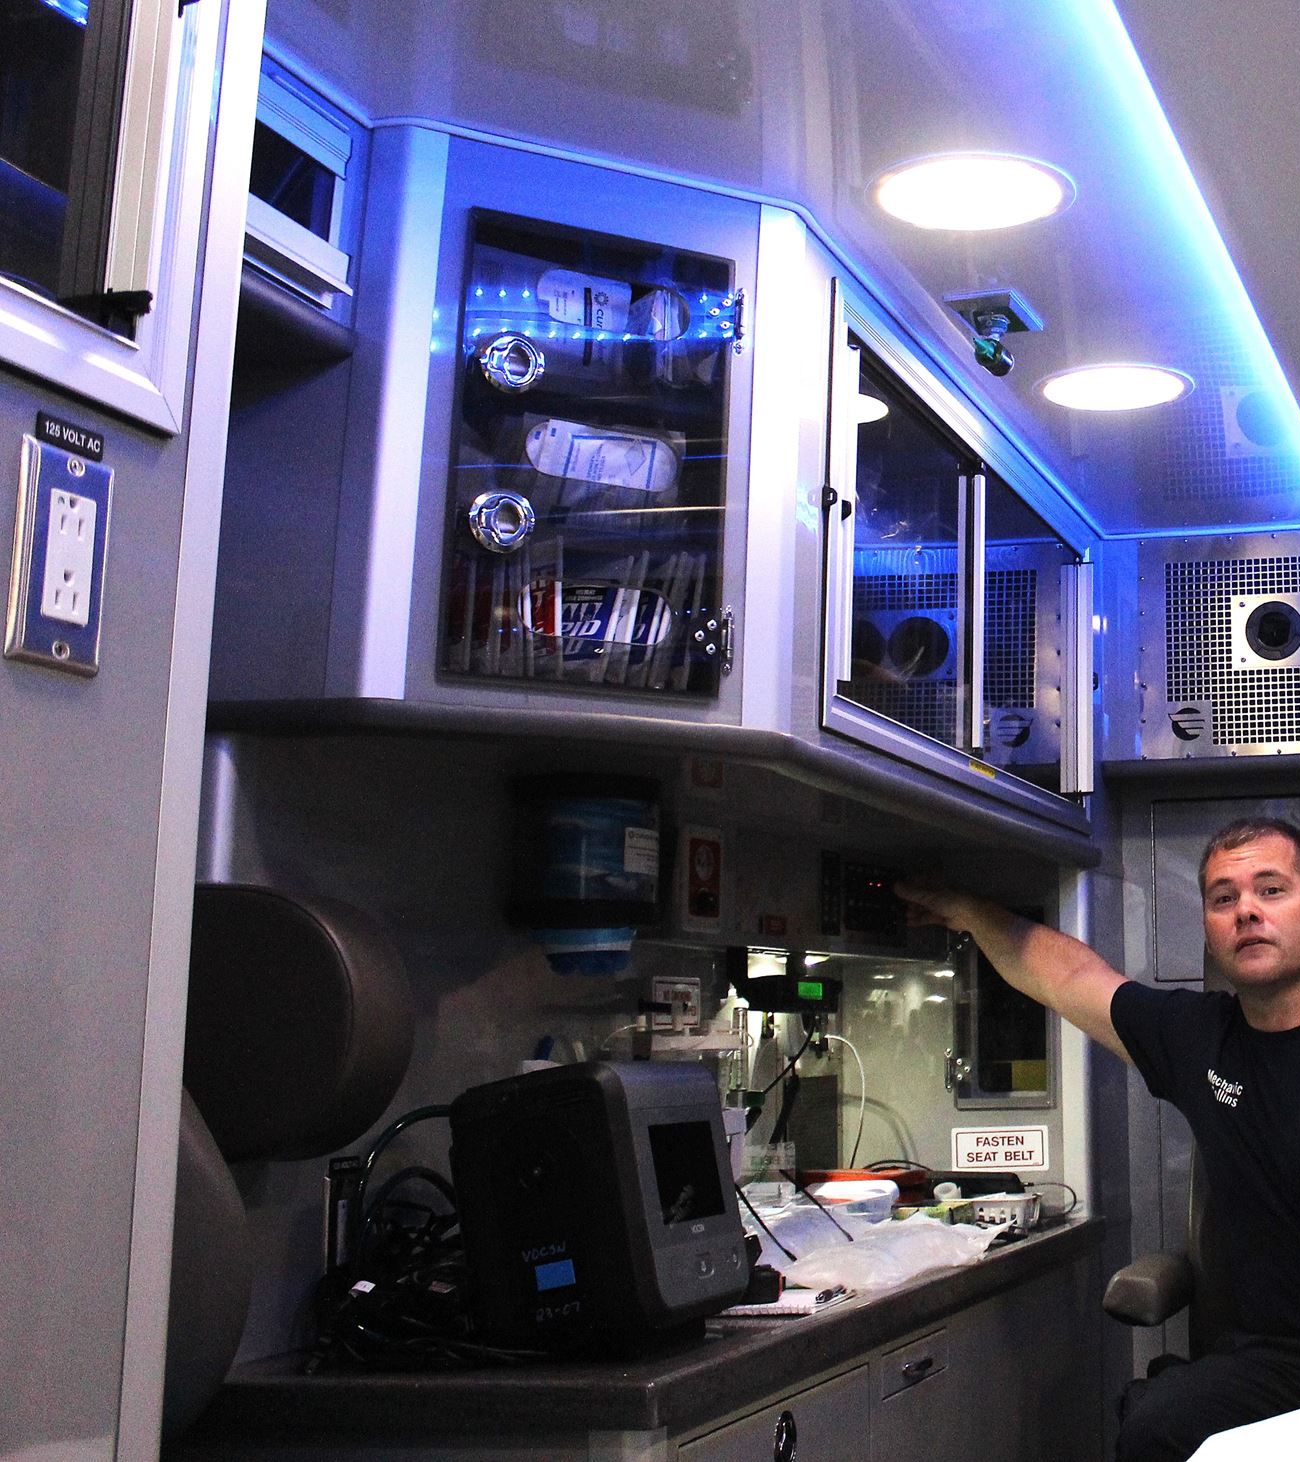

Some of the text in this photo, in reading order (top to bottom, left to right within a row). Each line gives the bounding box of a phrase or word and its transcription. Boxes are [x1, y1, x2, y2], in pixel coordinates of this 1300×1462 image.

[45, 420, 101, 453] 125 VOLT AC
[976, 1136, 1024, 1147] FASTEN
[966, 1150, 1035, 1163] SEAT BELT
